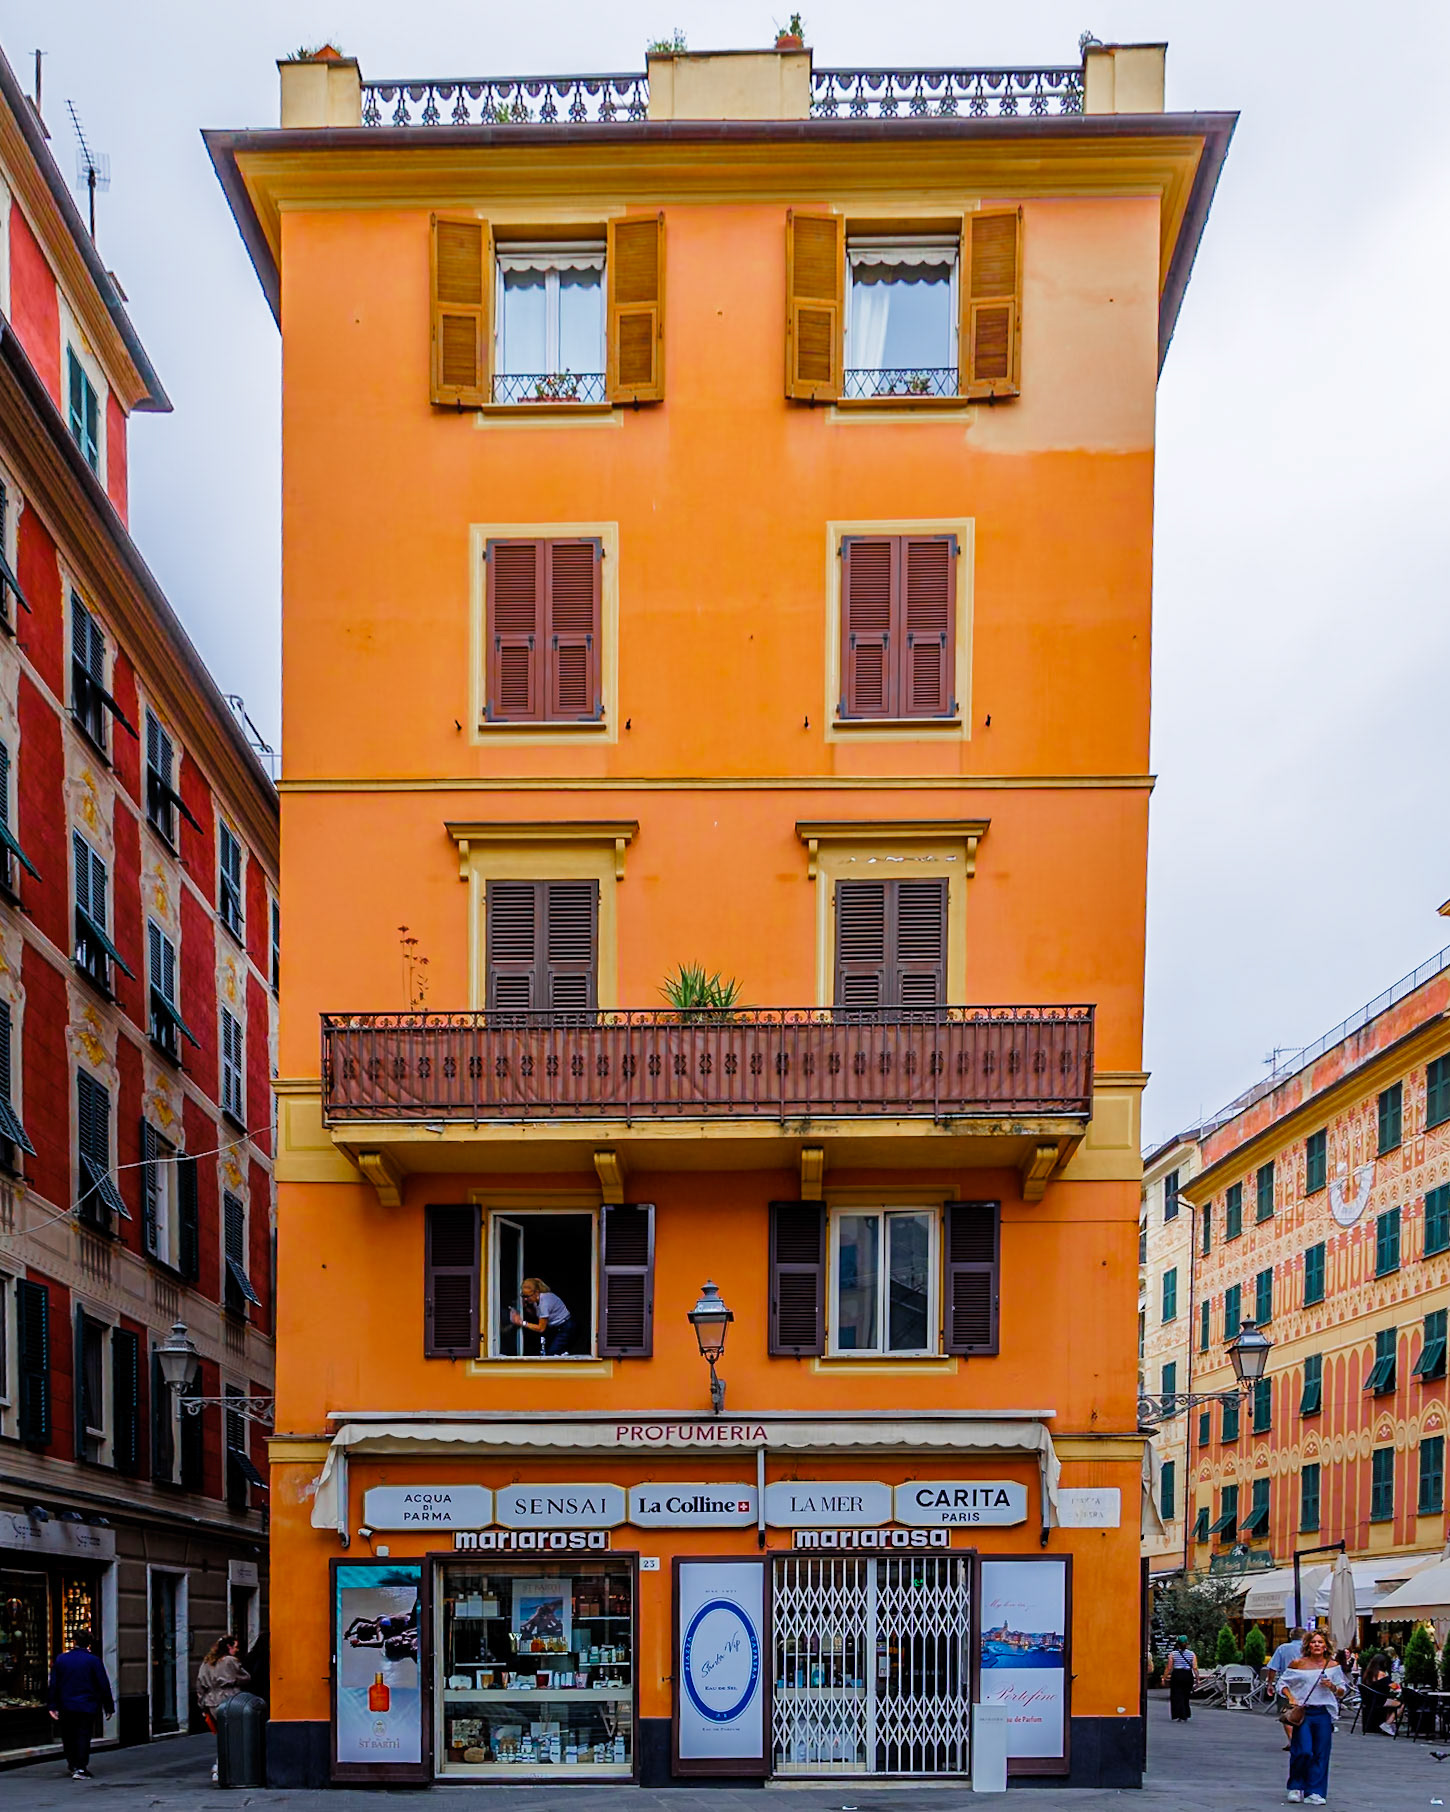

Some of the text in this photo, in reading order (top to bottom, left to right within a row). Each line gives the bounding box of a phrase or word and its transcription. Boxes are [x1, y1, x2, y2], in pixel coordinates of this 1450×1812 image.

[616, 1425, 768, 1441] PROFUMERIA
[404, 1494, 452, 1504] ACQUA
[638, 1496, 736, 1513] La Colline
[790, 1496, 864, 1512] LA MER
[915, 1488, 1011, 1507] CARITA
[514, 1497, 606, 1515] SENSAI
[404, 1512, 452, 1521] PARMA
[942, 1512, 980, 1522] PARIS
[455, 1531, 606, 1549] mariarosa
[796, 1529, 947, 1548] mariarosa
[643, 1560, 655, 1568] 23
[990, 1684, 1057, 1707] Portofino
[1014, 1715, 1022, 1723] de
[1022, 1715, 1043, 1723] Parfum
[359, 1741, 400, 1749] ST BARTH
